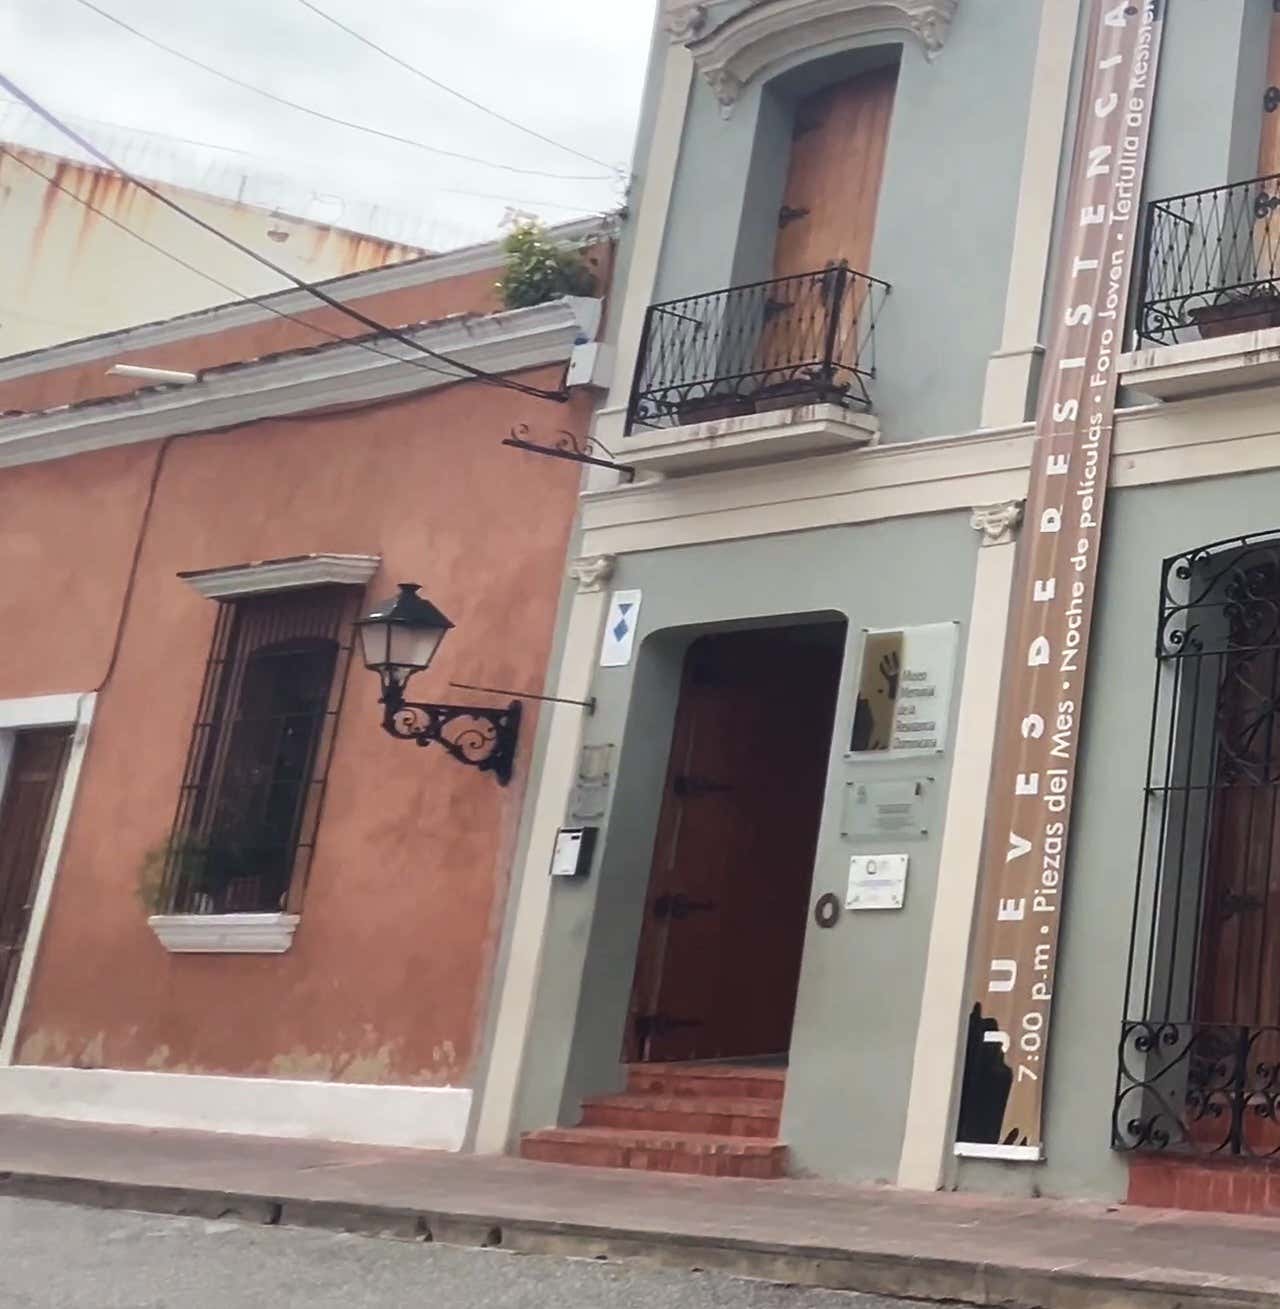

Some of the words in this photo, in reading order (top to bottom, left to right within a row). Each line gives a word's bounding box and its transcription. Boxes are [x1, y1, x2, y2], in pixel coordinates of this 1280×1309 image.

[1125, 97, 1144, 127] de
[1098, 250, 1123, 319] Joven
[1090, 328, 1113, 388] Foro
[1077, 412, 1102, 528] películas
[1070, 538, 1089, 572] de
[1059, 581, 1084, 671] Noche
[1051, 700, 1074, 756] Mes
[984, 714, 1045, 1053] JUEVES
[1027, 578, 1056, 666] DE
[1041, 769, 1068, 812] del
[1033, 822, 1063, 913] Piezas
[1019, 1012, 1042, 1081] 7:00
